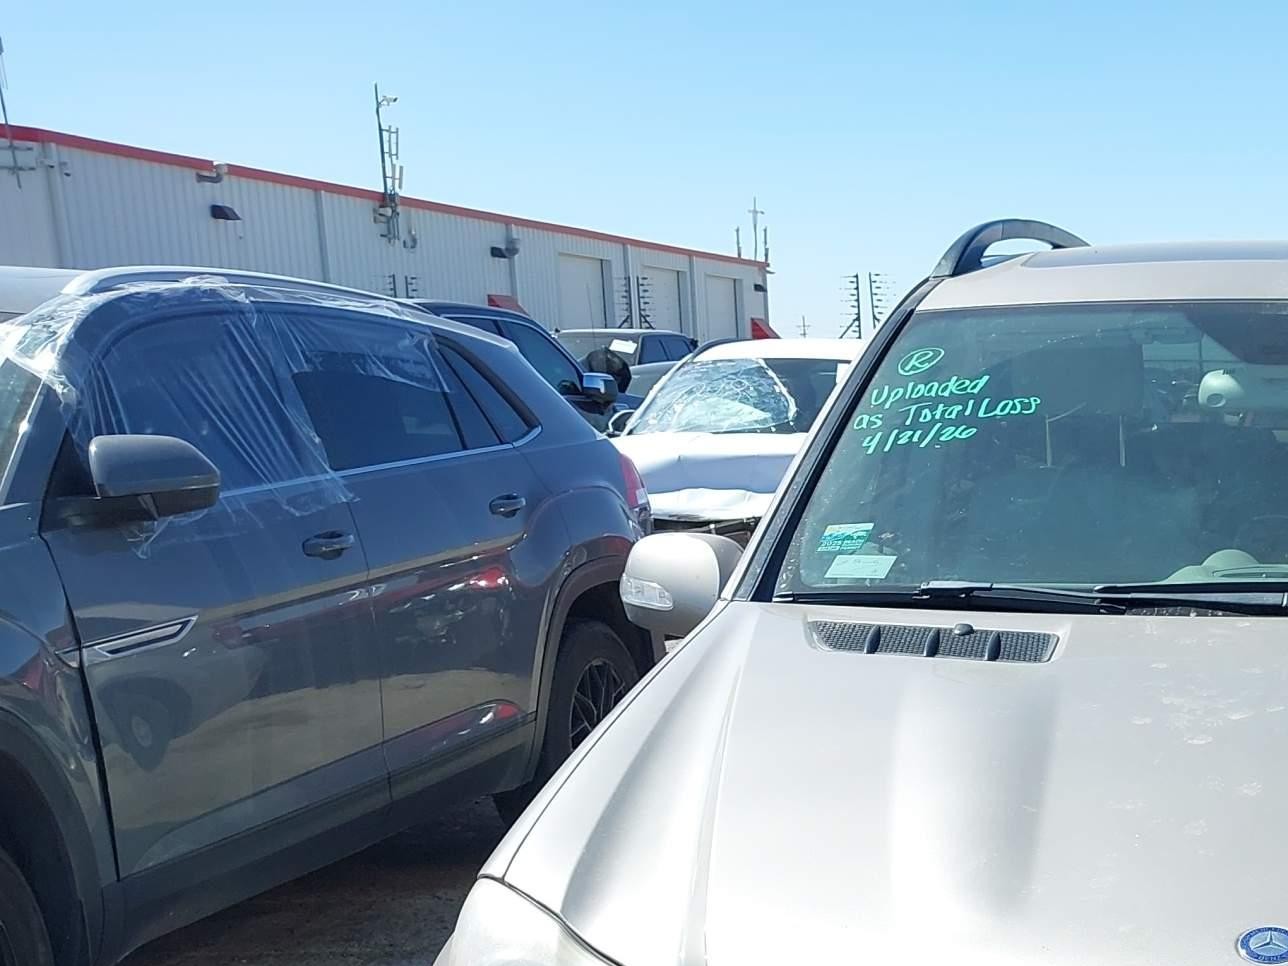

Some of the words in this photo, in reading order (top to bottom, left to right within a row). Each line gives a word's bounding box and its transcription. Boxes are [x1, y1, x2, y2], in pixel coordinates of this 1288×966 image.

[871, 375, 991, 409] Uploaded
[853, 413, 883, 430] as
[899, 402, 975, 426] Total
[861, 423, 978, 455] 4/21/26
